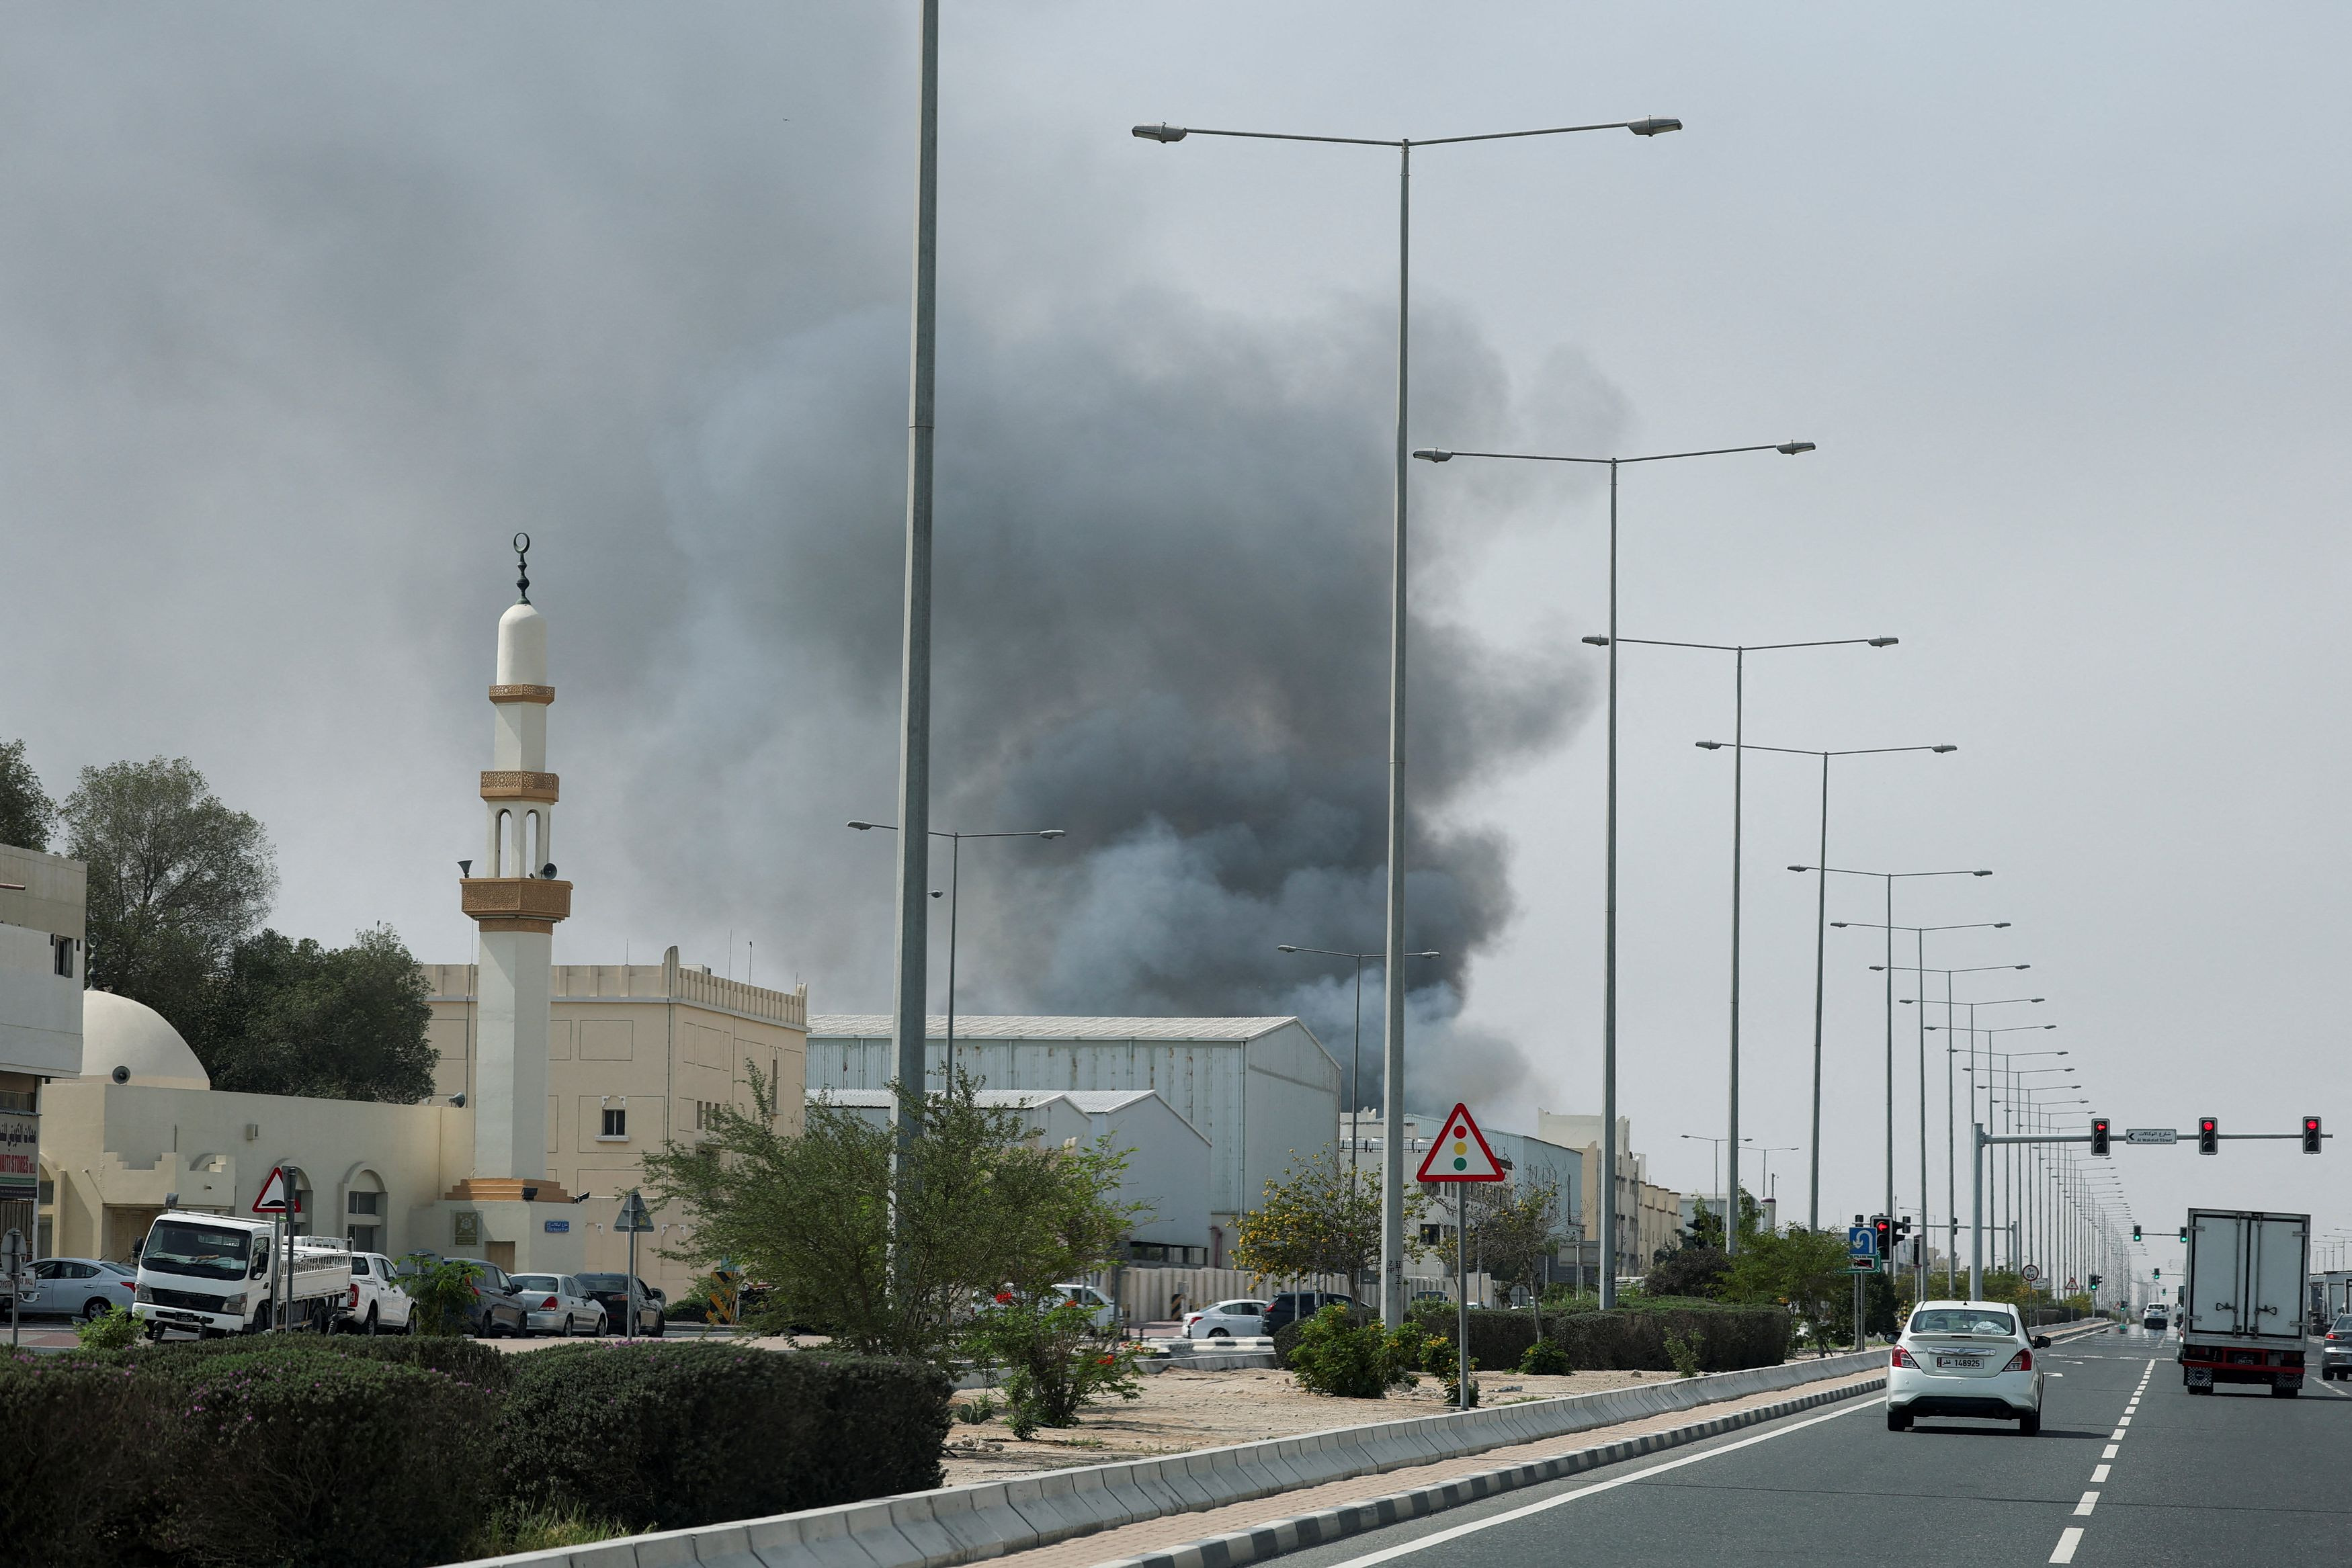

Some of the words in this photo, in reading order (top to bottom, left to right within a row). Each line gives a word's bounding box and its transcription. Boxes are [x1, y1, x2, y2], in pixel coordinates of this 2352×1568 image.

[0, 1154, 11, 1172] AITI
[11, 1155, 29, 1174] STORES
[1955, 1359, 1980, 1367] 148925
